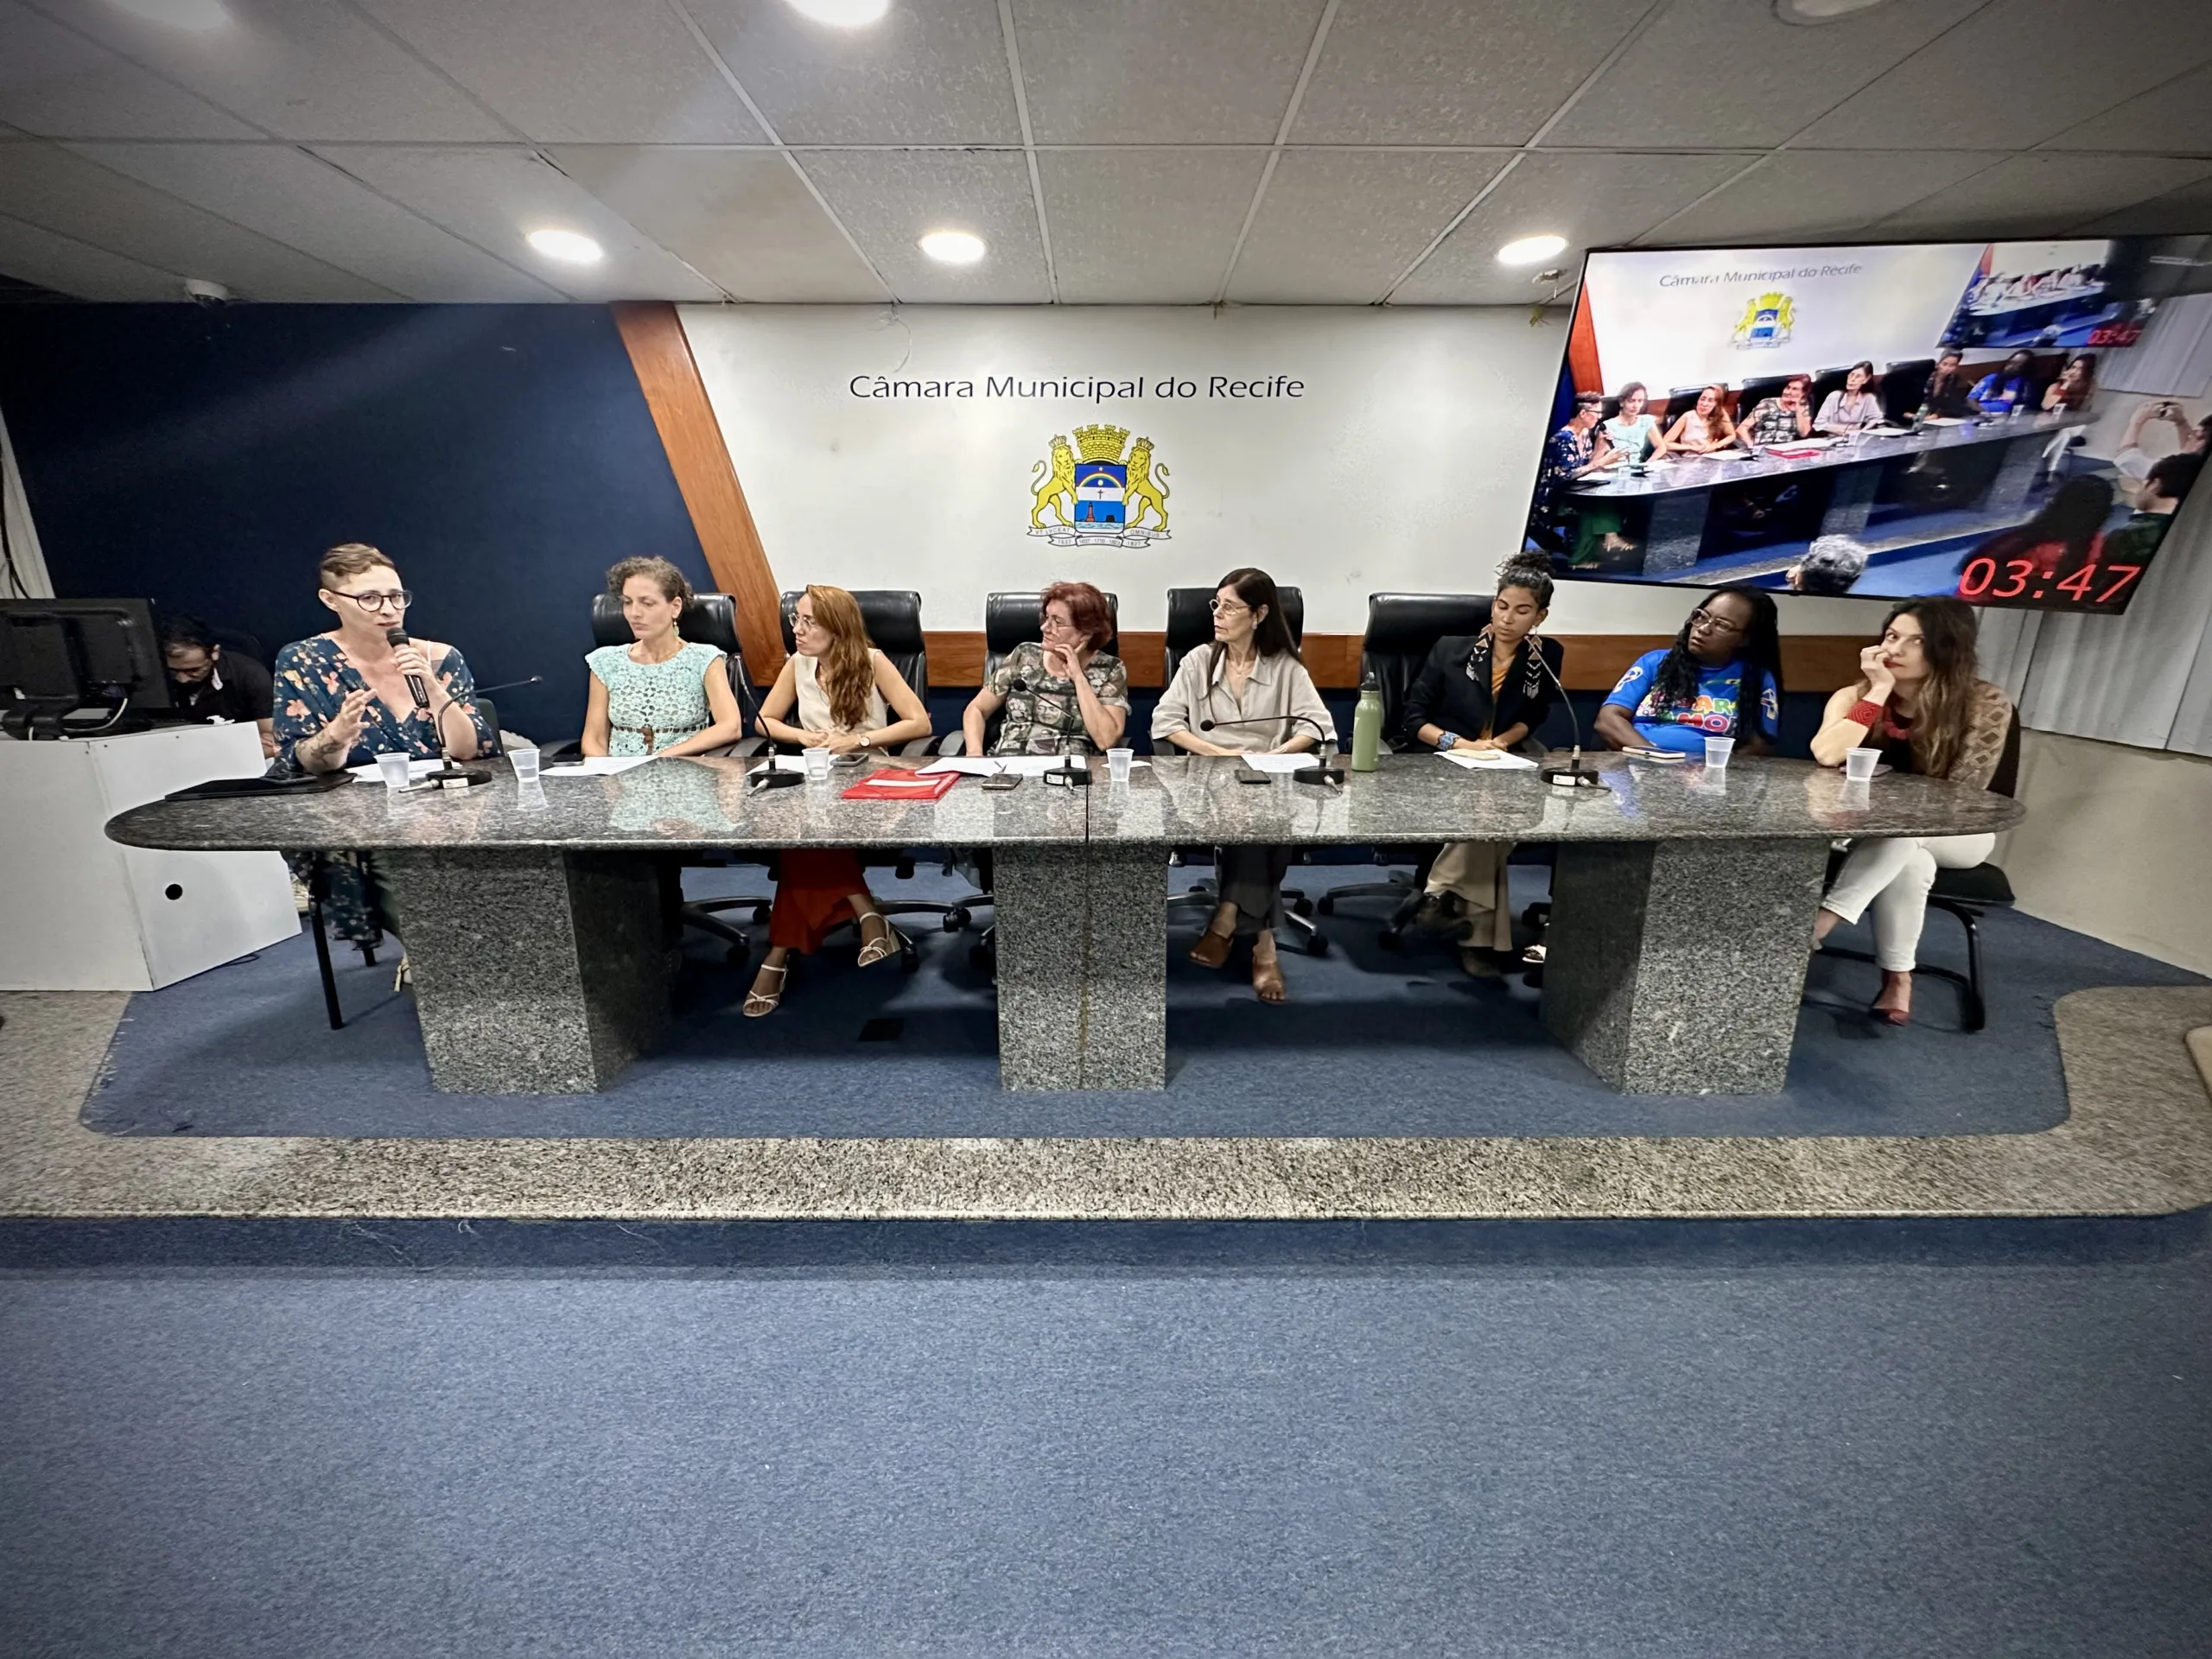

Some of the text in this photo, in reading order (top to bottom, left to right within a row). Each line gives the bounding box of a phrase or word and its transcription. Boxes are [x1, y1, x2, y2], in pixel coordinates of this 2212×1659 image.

[1724, 269, 1796, 283] Municipal
[1798, 266, 1817, 278] do
[1821, 263, 1864, 276] Recife
[849, 375, 1305, 404] Câmara Municipal do Recife
[1959, 557, 2141, 603] 03:47
